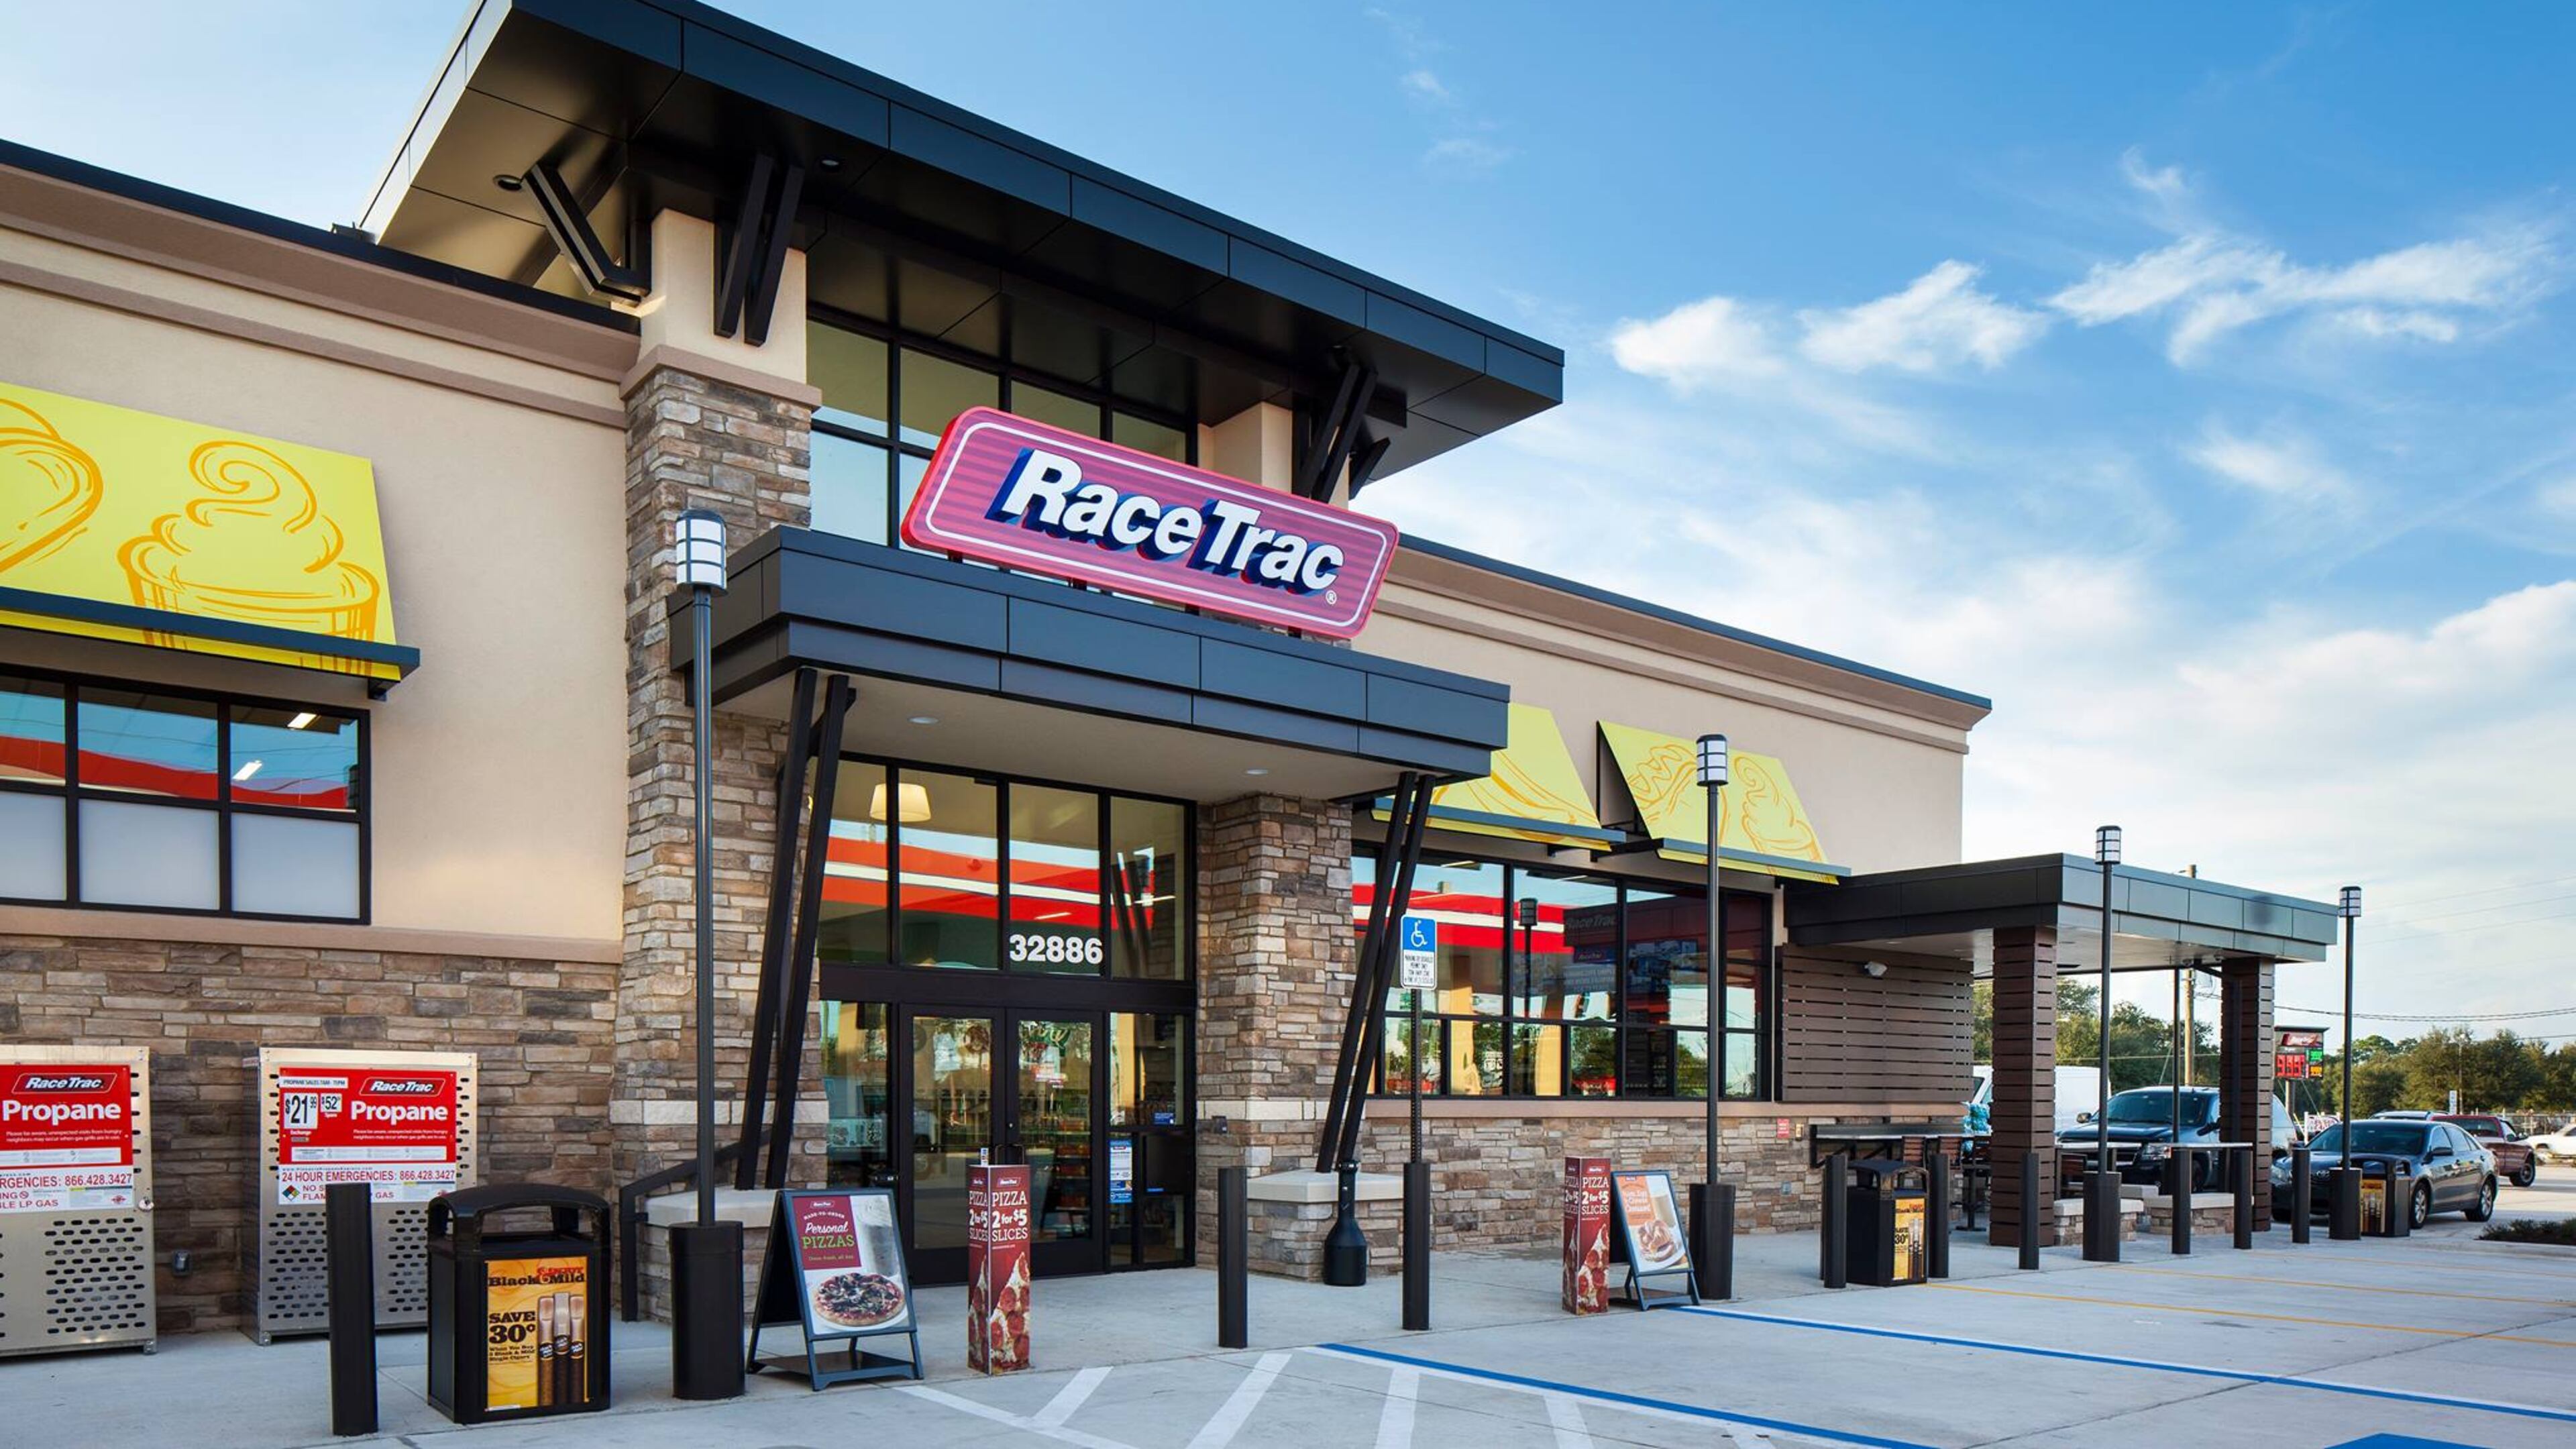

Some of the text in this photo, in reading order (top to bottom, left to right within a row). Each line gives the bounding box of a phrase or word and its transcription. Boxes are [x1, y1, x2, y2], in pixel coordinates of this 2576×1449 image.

[989, 448, 1345, 594] RaceTrac
[1010, 934, 1104, 965] 32886
[25, 1077, 102, 1089] RaceTrac
[370, 1080, 434, 1092] RaceTrac
[2, 1099, 122, 1126] Propane
[350, 1100, 449, 1126] Propane
[64, 1173, 132, 1187] 866.428.3427
[282, 1169, 455, 1182] 24 HOUR EMERGENCIES: 866.428.3427
[1582, 1176, 1609, 1189] PIZZA
[36, 1199, 59, 1208] GAS
[969, 1191, 988, 1207] PIZZA
[991, 1190, 1028, 1208] PIZZA
[1582, 1191, 1589, 1205] 2
[1599, 1190, 1609, 1205] $5
[1582, 1205, 1609, 1215] SLICES
[991, 1208, 1028, 1229] 2 for $5
[805, 1221, 849, 1234] Personal
[969, 1227, 989, 1242] SLICES
[991, 1227, 1028, 1242] SLICES
[802, 1234, 855, 1249] PIZZAS
[488, 1275, 539, 1287] Black
[549, 1273, 585, 1283] Mild
[489, 1311, 535, 1324] SAVE
